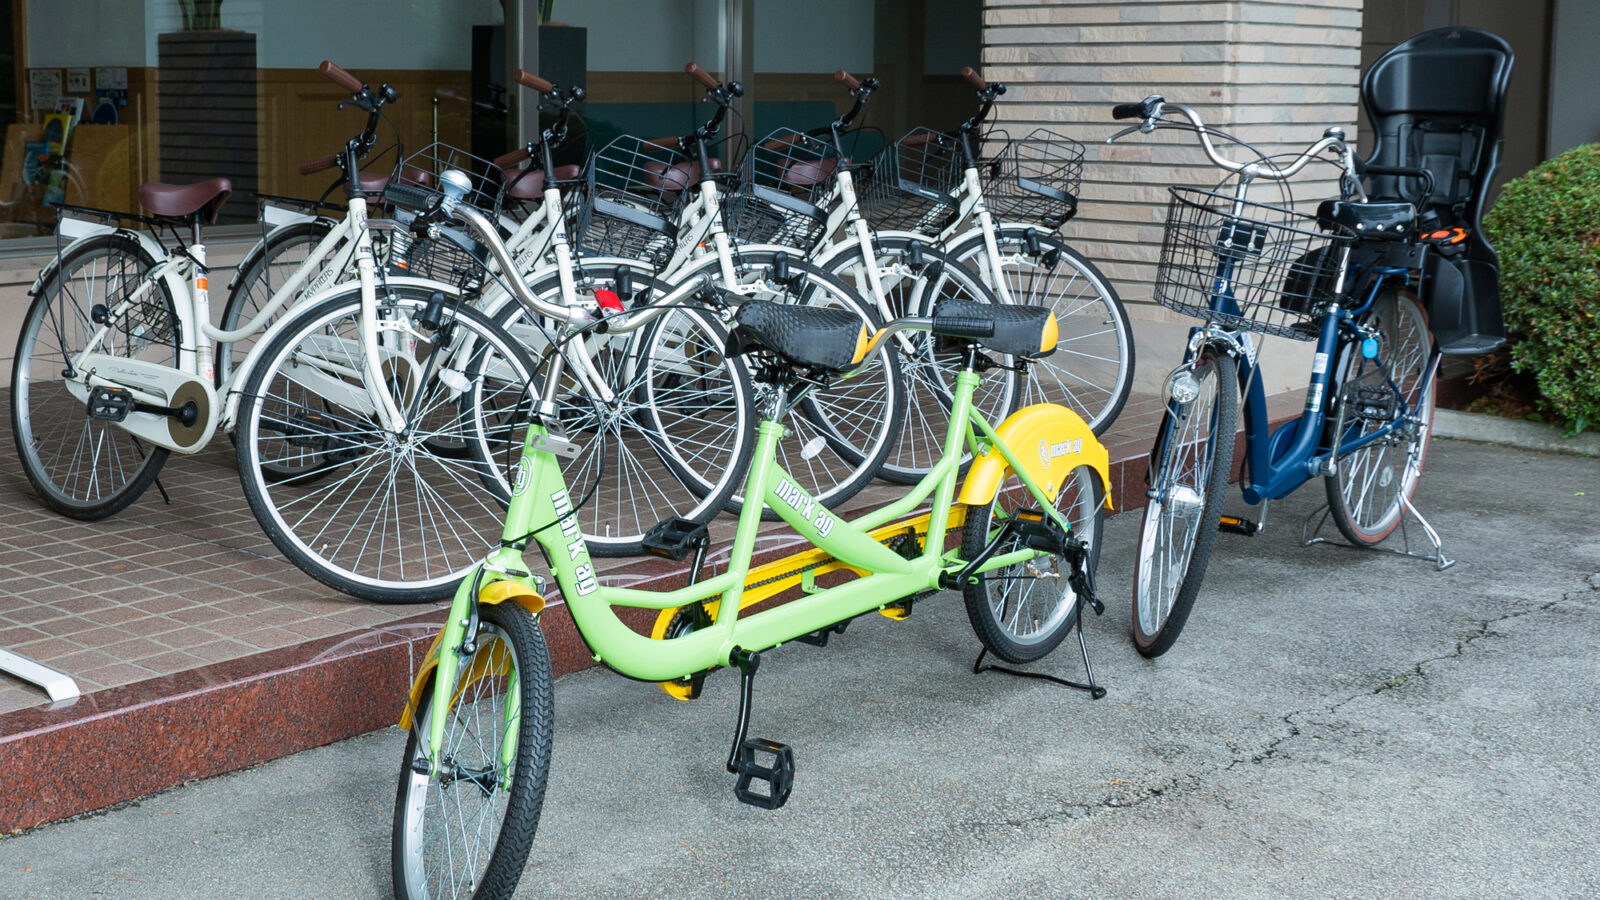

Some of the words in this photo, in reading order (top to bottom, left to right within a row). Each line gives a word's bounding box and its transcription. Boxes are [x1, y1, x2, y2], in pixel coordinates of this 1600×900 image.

[1051, 439, 1072, 458] mark
[1073, 438, 1083, 454] ag
[774, 477, 816, 522] mark
[813, 509, 835, 539] ag
[550, 487, 586, 562] mark
[575, 561, 600, 597] ag
